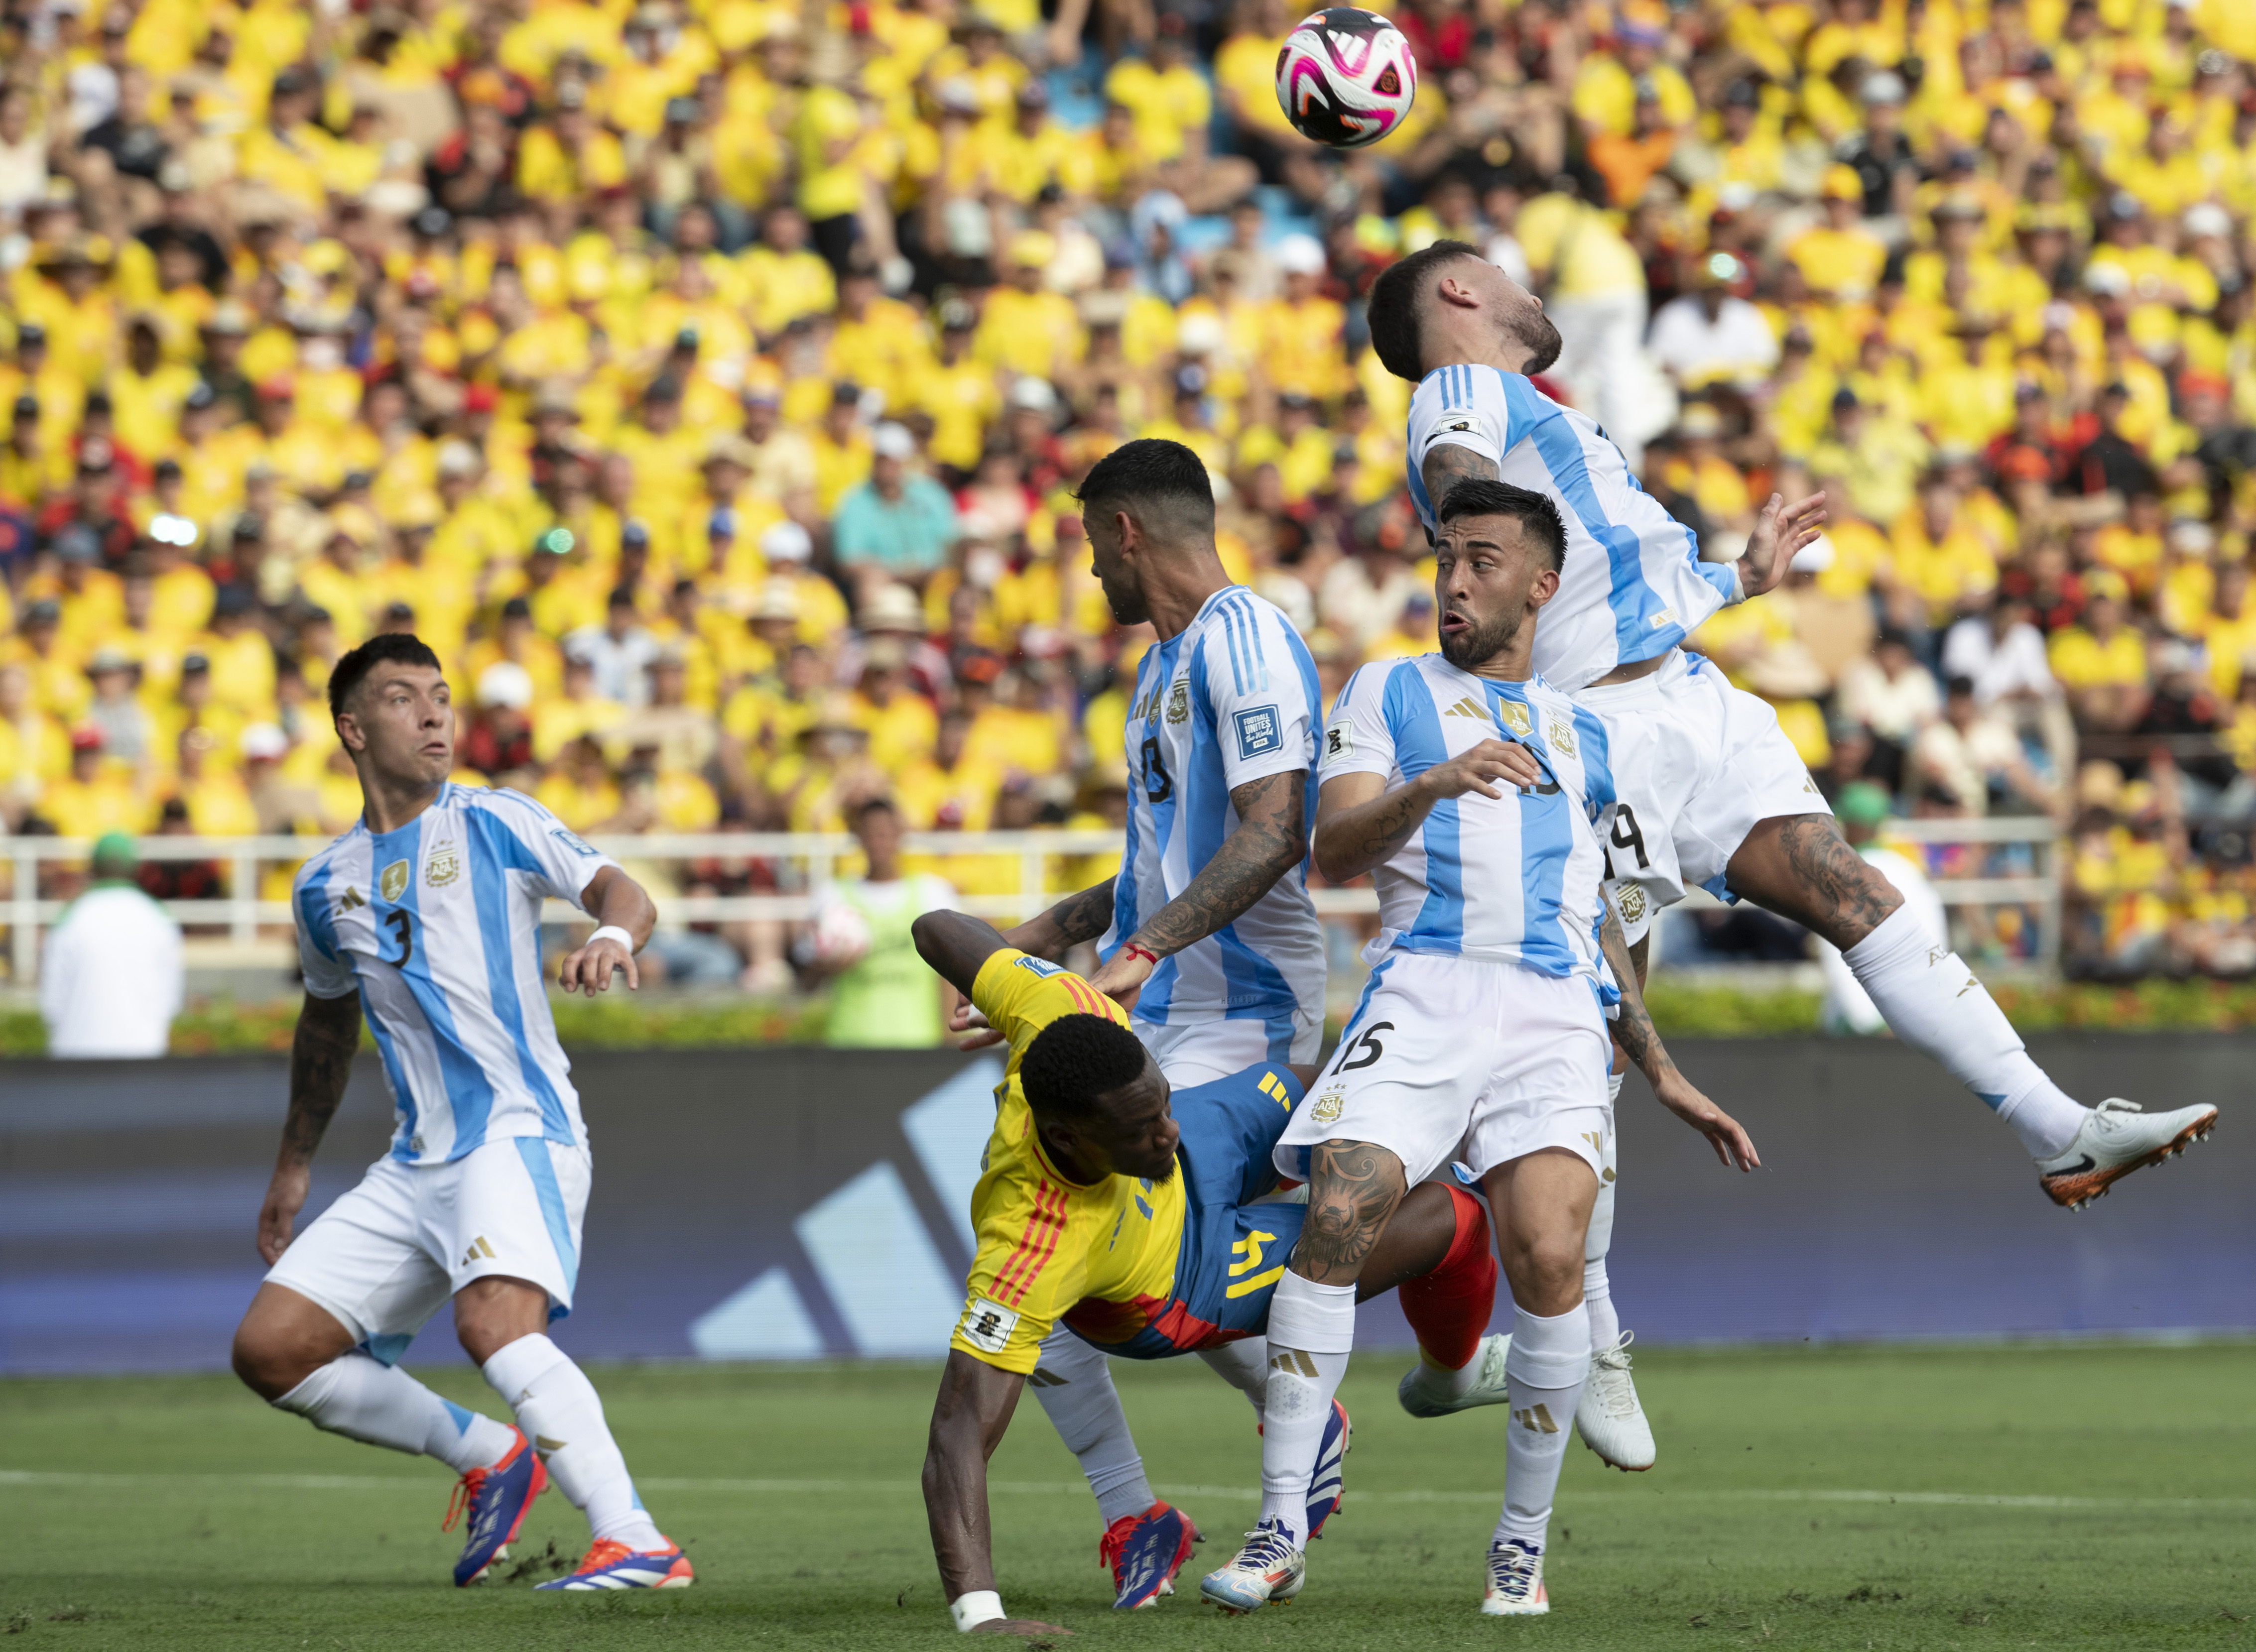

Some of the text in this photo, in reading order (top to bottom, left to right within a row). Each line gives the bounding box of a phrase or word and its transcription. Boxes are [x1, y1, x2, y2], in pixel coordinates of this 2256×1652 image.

[1243, 713, 1270, 725] FOOTBALL
[1245, 719, 1271, 734] UNITES
[1245, 734, 1255, 743] the
[1556, 725, 1571, 748] AFA
[1626, 893, 1642, 913] AFA
[384, 909, 412, 970] 3
[1329, 1021, 1394, 1077] 15
[1317, 1097, 1337, 1113] AFA
